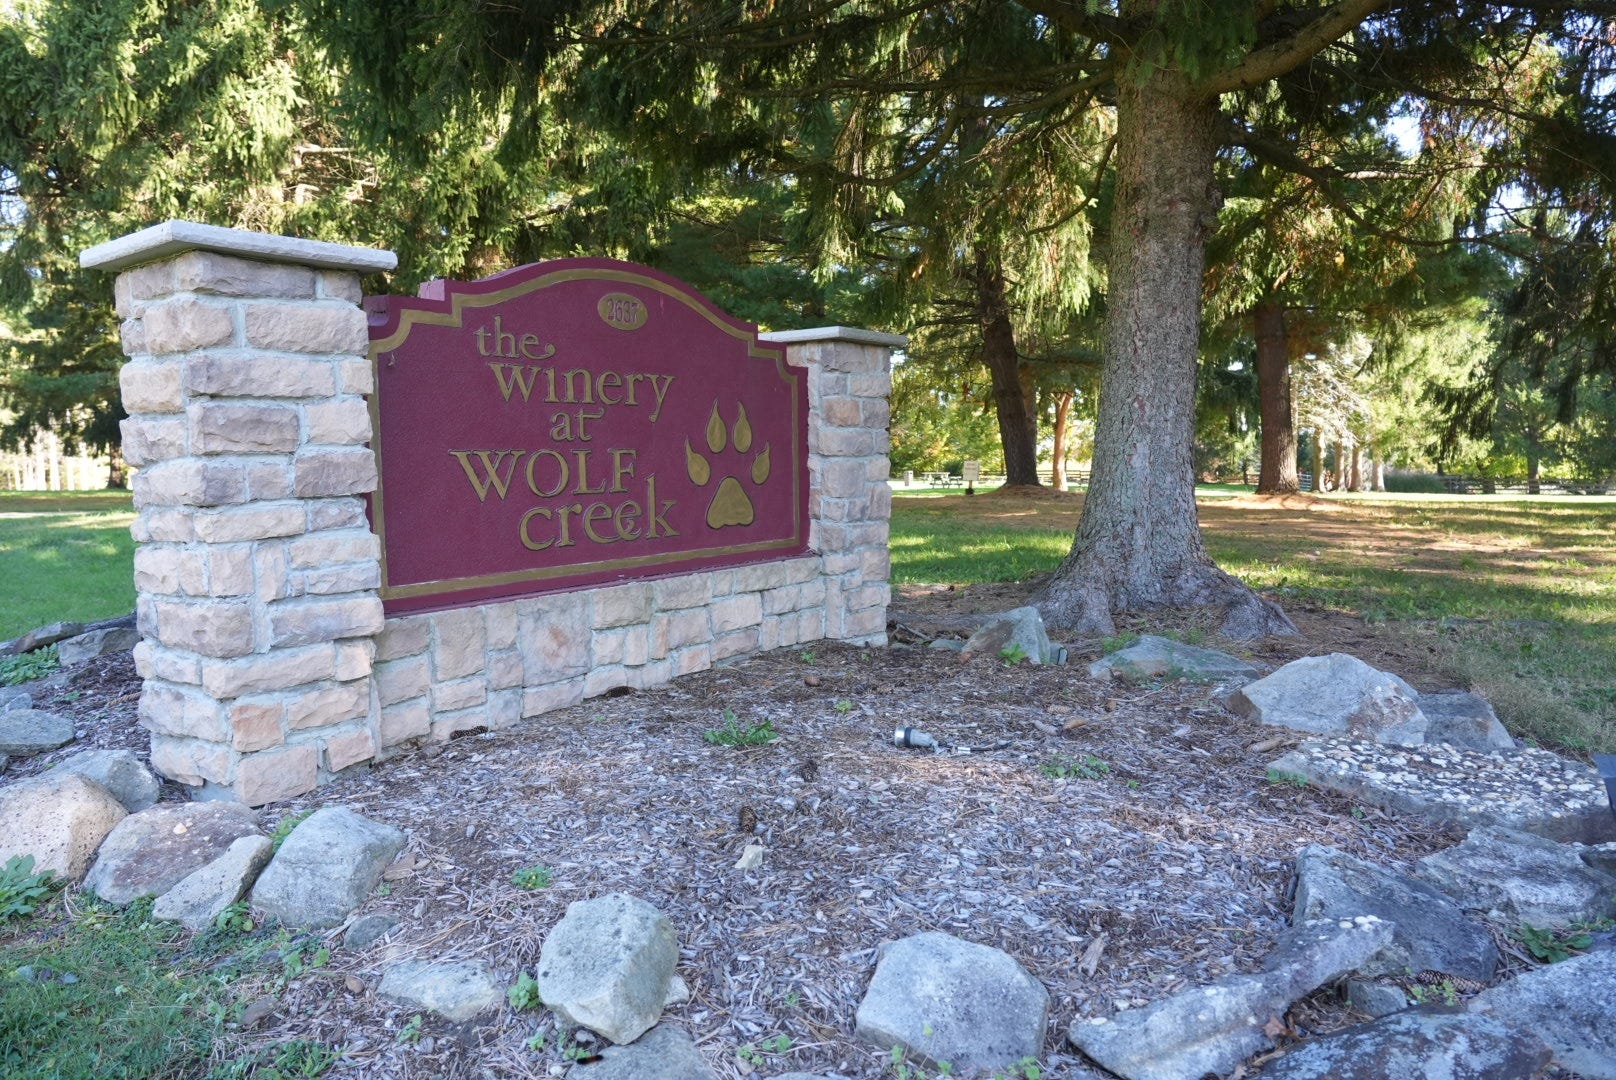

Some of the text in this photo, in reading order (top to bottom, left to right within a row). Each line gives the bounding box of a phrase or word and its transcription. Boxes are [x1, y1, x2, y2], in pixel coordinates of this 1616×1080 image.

[607, 298, 640, 323] 2637
[474, 316, 556, 360] the
[488, 360, 676, 424] Winery
[549, 406, 605, 443] at
[449, 448, 638, 502] WOLF
[518, 474, 681, 552] creek
